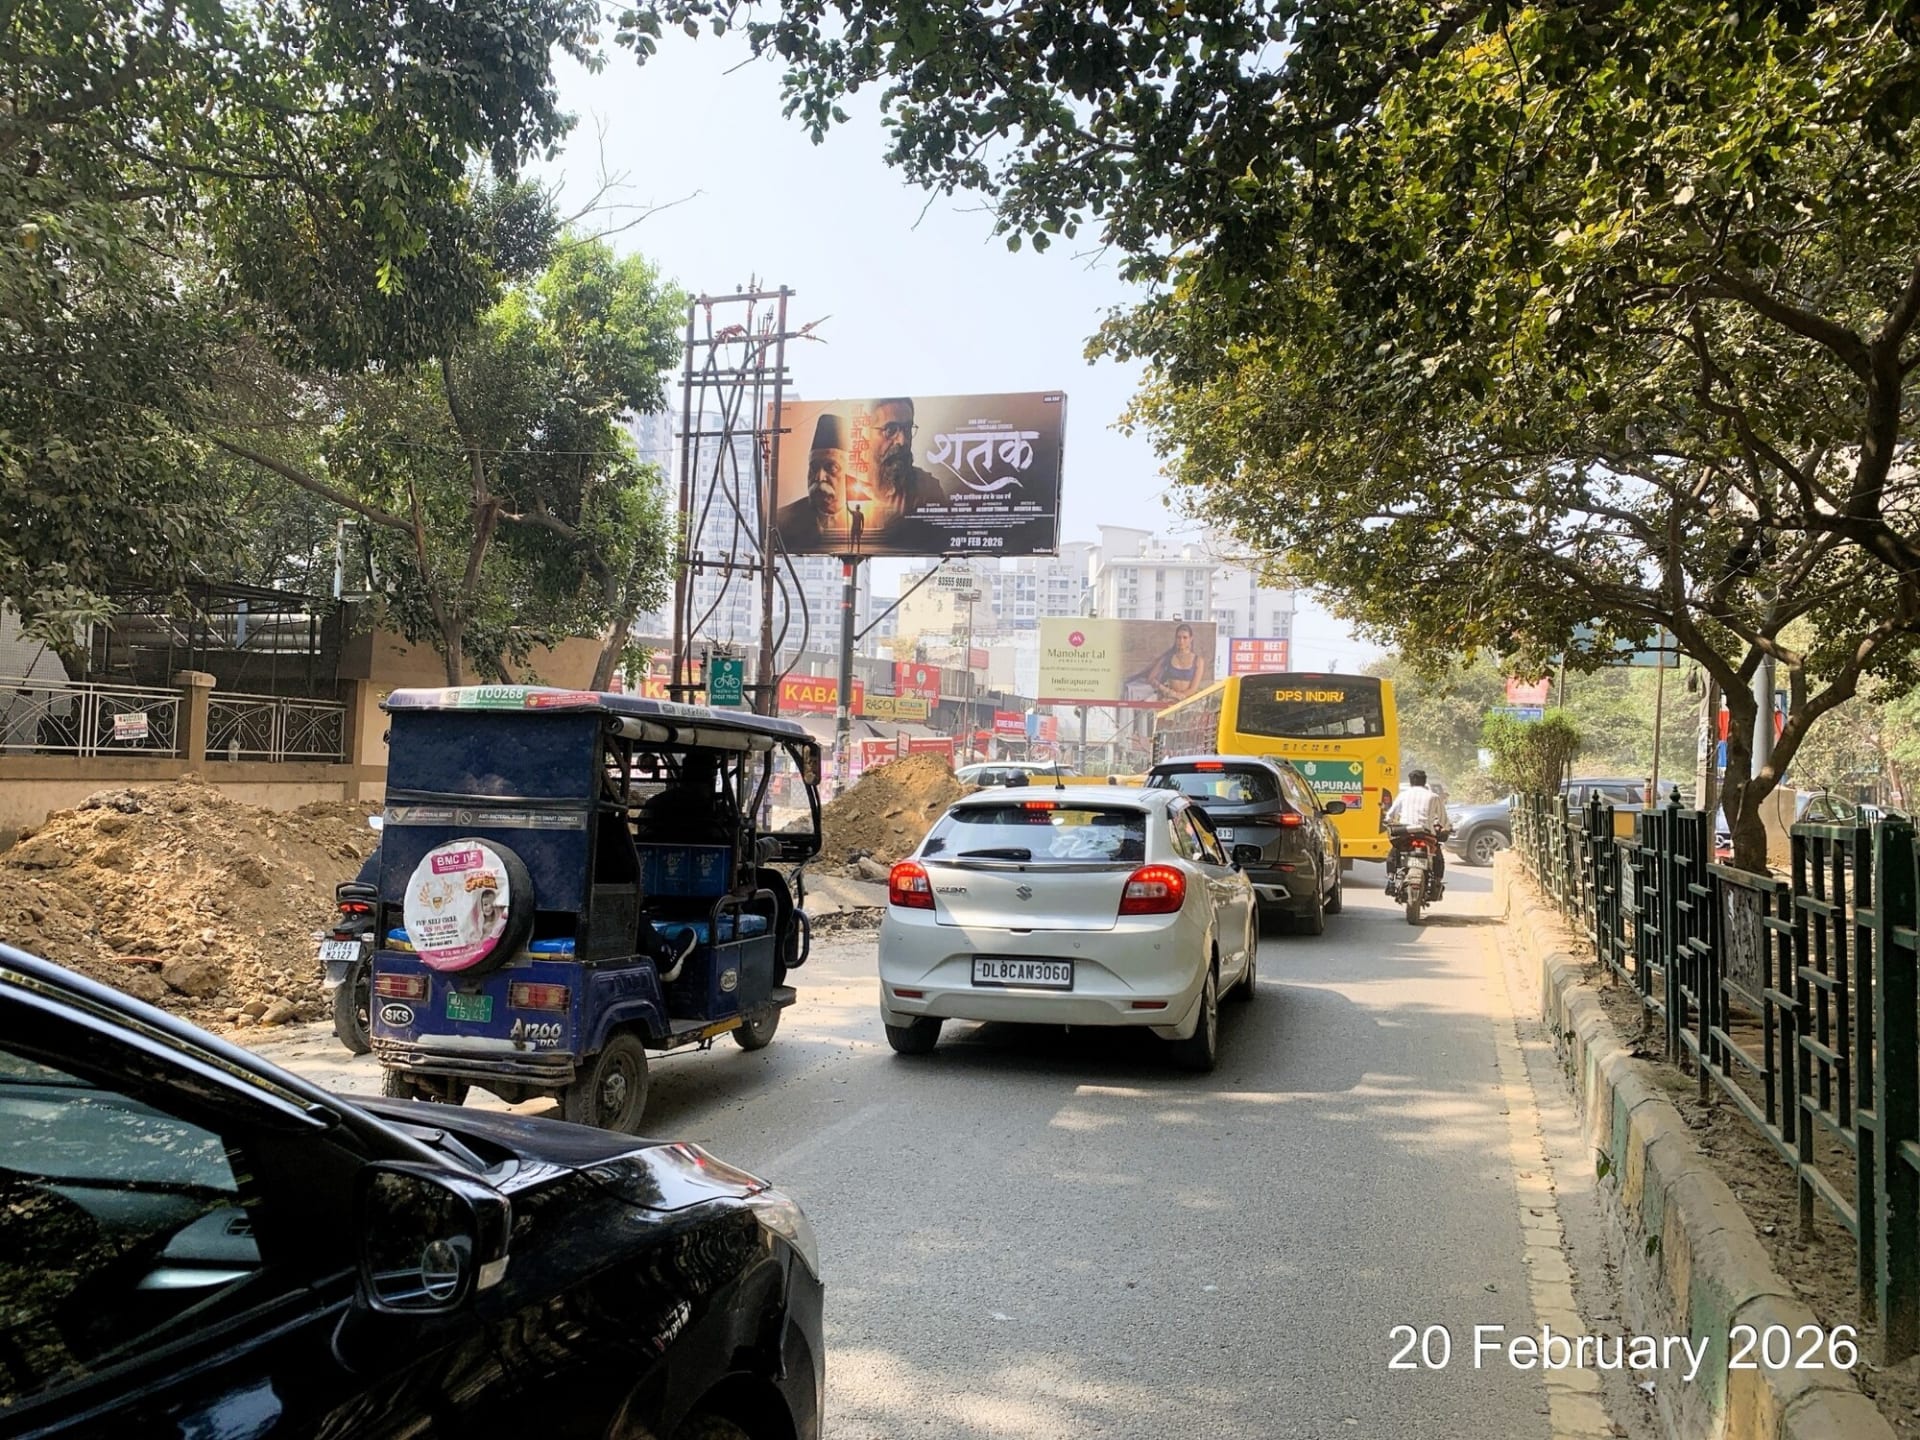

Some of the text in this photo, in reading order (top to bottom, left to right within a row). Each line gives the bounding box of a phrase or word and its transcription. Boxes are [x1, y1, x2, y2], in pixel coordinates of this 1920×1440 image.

[927, 431, 1040, 491] शतक
[968, 537, 981, 547] FEB
[982, 537, 1004, 547] 2026
[1238, 641, 1282, 651] JEE NEET
[1047, 648, 1105, 659] Manohar Lal
[1263, 653, 1282, 663] CLAT
[1051, 677, 1099, 686] Indirapuram
[1276, 690, 1303, 701] DPS
[1282, 743, 1342, 752] EICHER
[437, 851, 479, 866] BMC IVF
[982, 962, 1069, 981] DL8CAN3060
[385, 1009, 409, 1022] SKS
